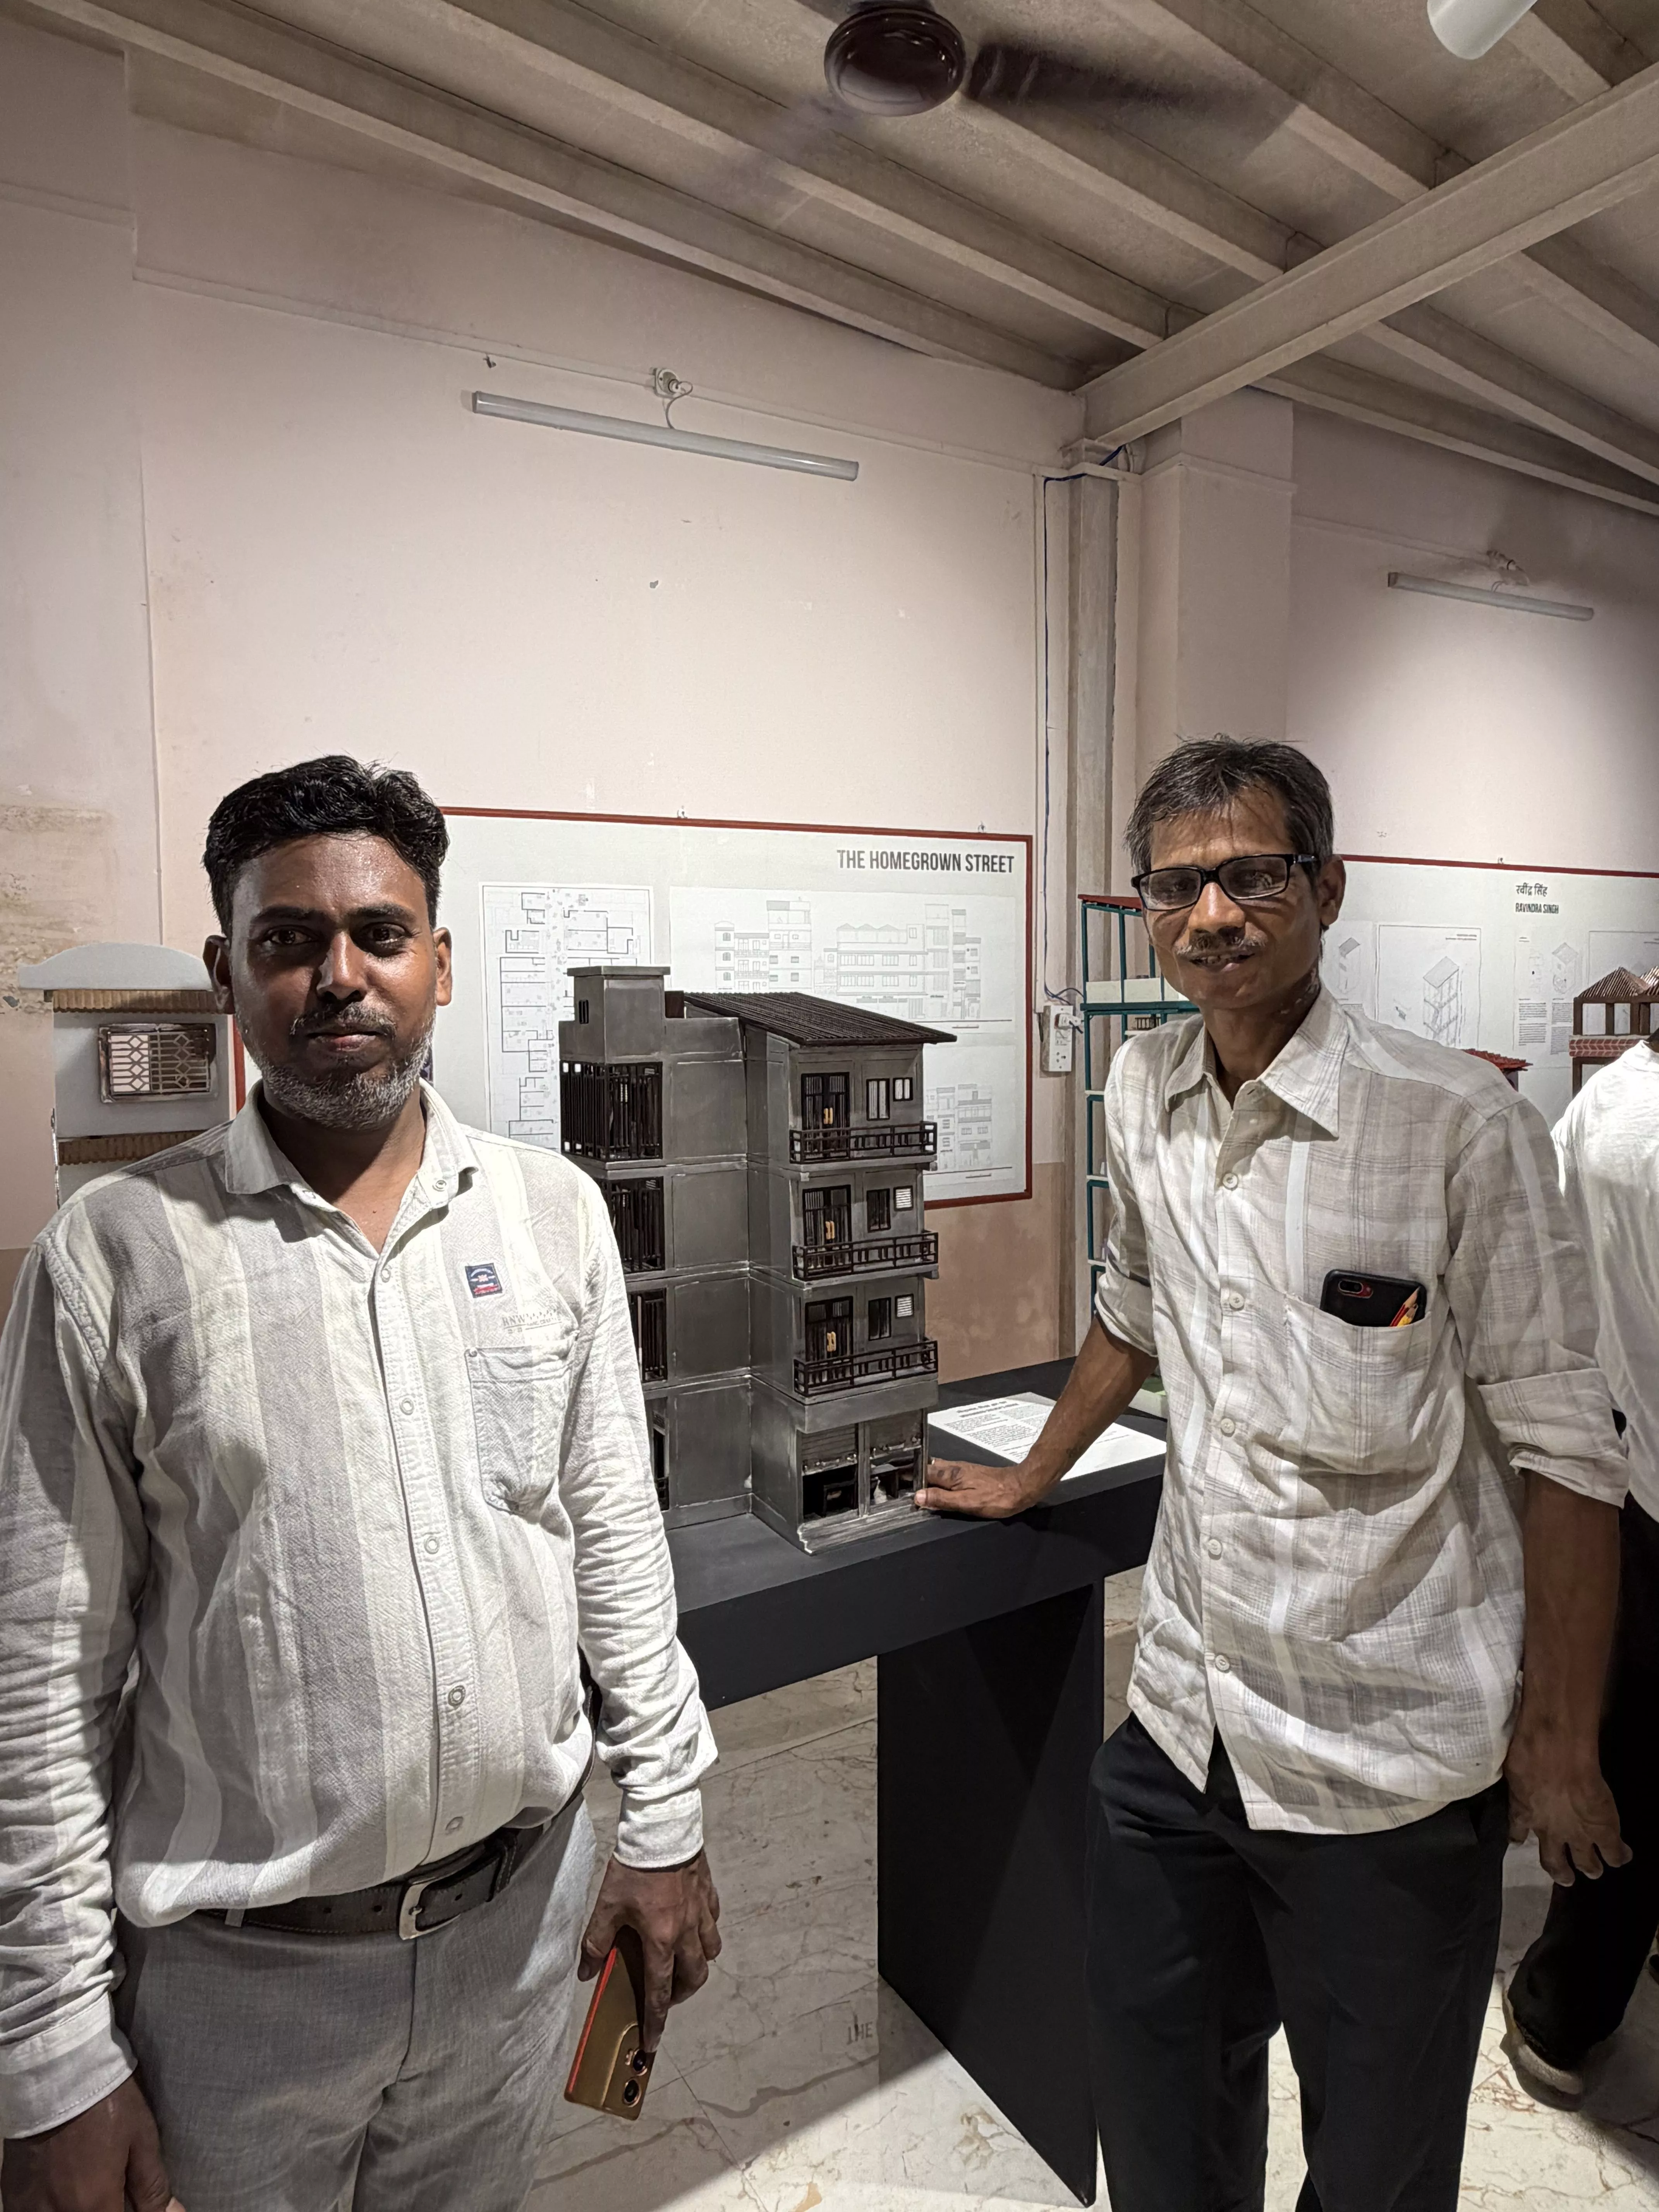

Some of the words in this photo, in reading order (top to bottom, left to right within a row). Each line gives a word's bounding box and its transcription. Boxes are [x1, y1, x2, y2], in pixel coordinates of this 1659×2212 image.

[837, 850, 866, 869] THE
[870, 850, 961, 871] HOMEGROWN
[965, 854, 1015, 873] STREET
[1534, 883, 1548, 897] सिंह
[1515, 902, 1542, 913] RAVINDRA
[1543, 904, 1559, 914] SINGH
